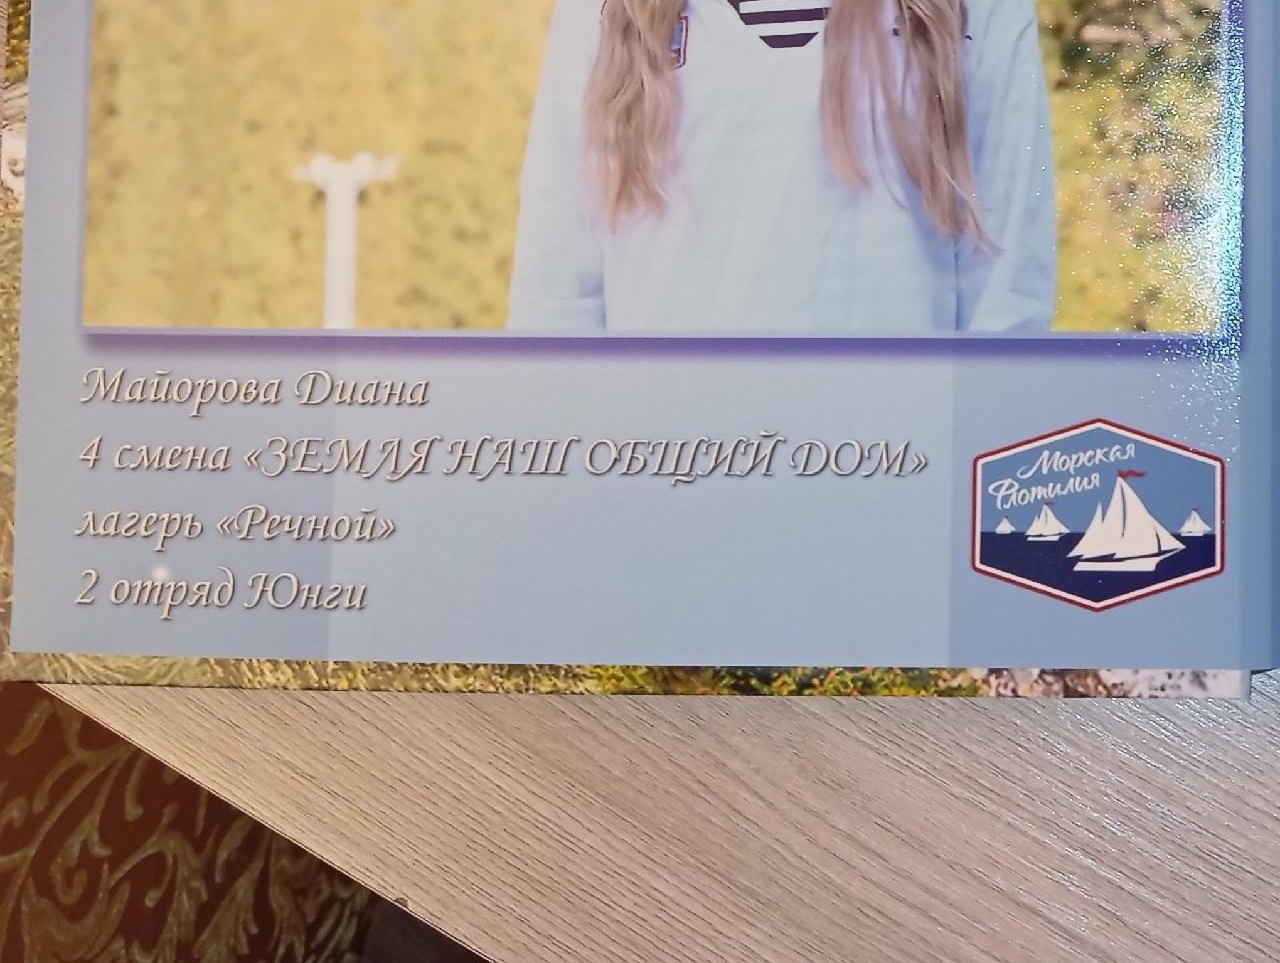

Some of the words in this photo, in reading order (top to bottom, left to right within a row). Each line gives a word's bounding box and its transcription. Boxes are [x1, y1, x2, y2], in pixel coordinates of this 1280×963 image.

[80, 367, 282, 417] Майорова
[294, 369, 430, 406] Диана
[79, 435, 103, 470] 4
[114, 444, 231, 472] смена
[244, 436, 442, 481] «ЗЕМЛЯ
[442, 435, 580, 481] НАШ
[584, 429, 786, 486] ОБЩИЙ
[789, 438, 929, 478] ДОМ»
[1016, 443, 1136, 479] Морская
[988, 472, 1100, 510] Флотилия
[73, 508, 203, 552] лагерь
[215, 504, 396, 542] «Речной»
[74, 568, 99, 605] 2
[110, 566, 236, 621] отряд
[243, 572, 367, 611] Юнги
